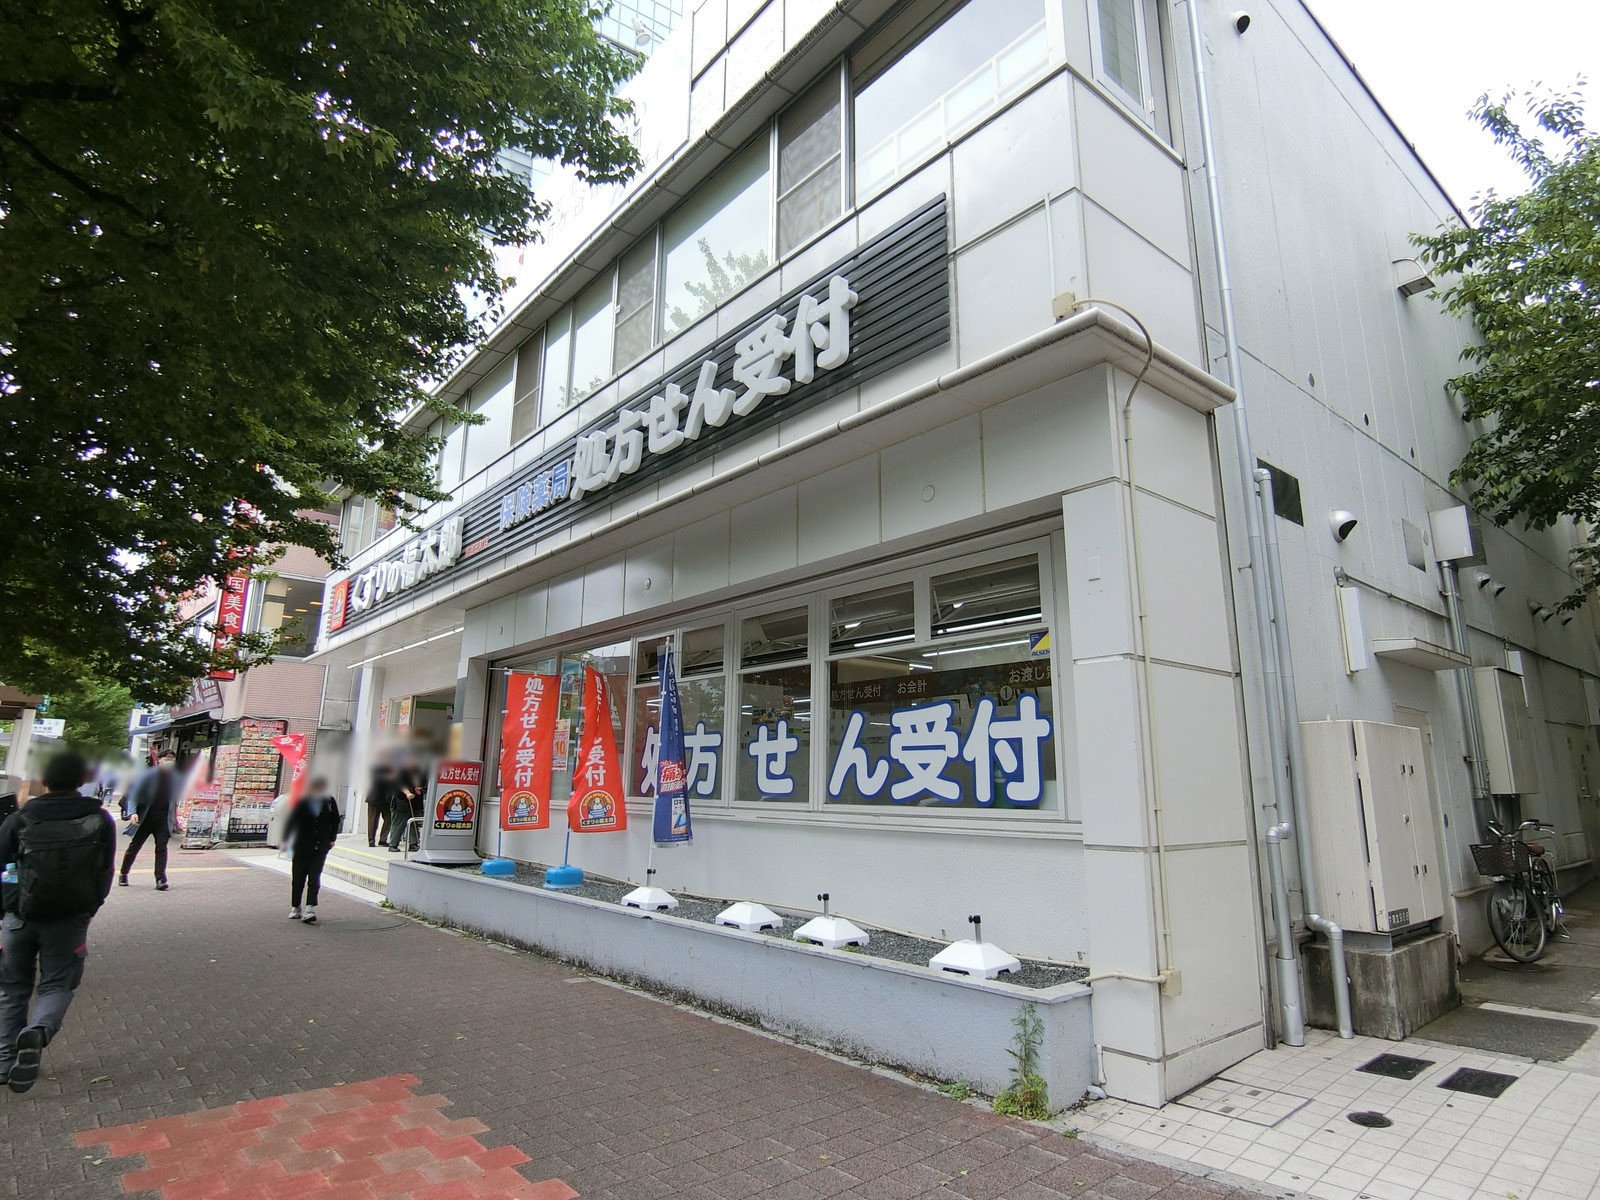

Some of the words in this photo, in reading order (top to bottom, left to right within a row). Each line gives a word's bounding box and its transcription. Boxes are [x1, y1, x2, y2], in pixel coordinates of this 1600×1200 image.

[570, 275, 858, 500] 処方せん受付
[499, 459, 572, 533] 保険薬局
[350, 516, 464, 612] くすりの福太郎
[832, 684, 882, 701] 処方せん受付
[897, 679, 927, 694] お会計
[514, 677, 544, 788] 処方せん受付
[440, 767, 480, 781] 処方せん受付
[435, 821, 472, 829] くすりの福太郎
